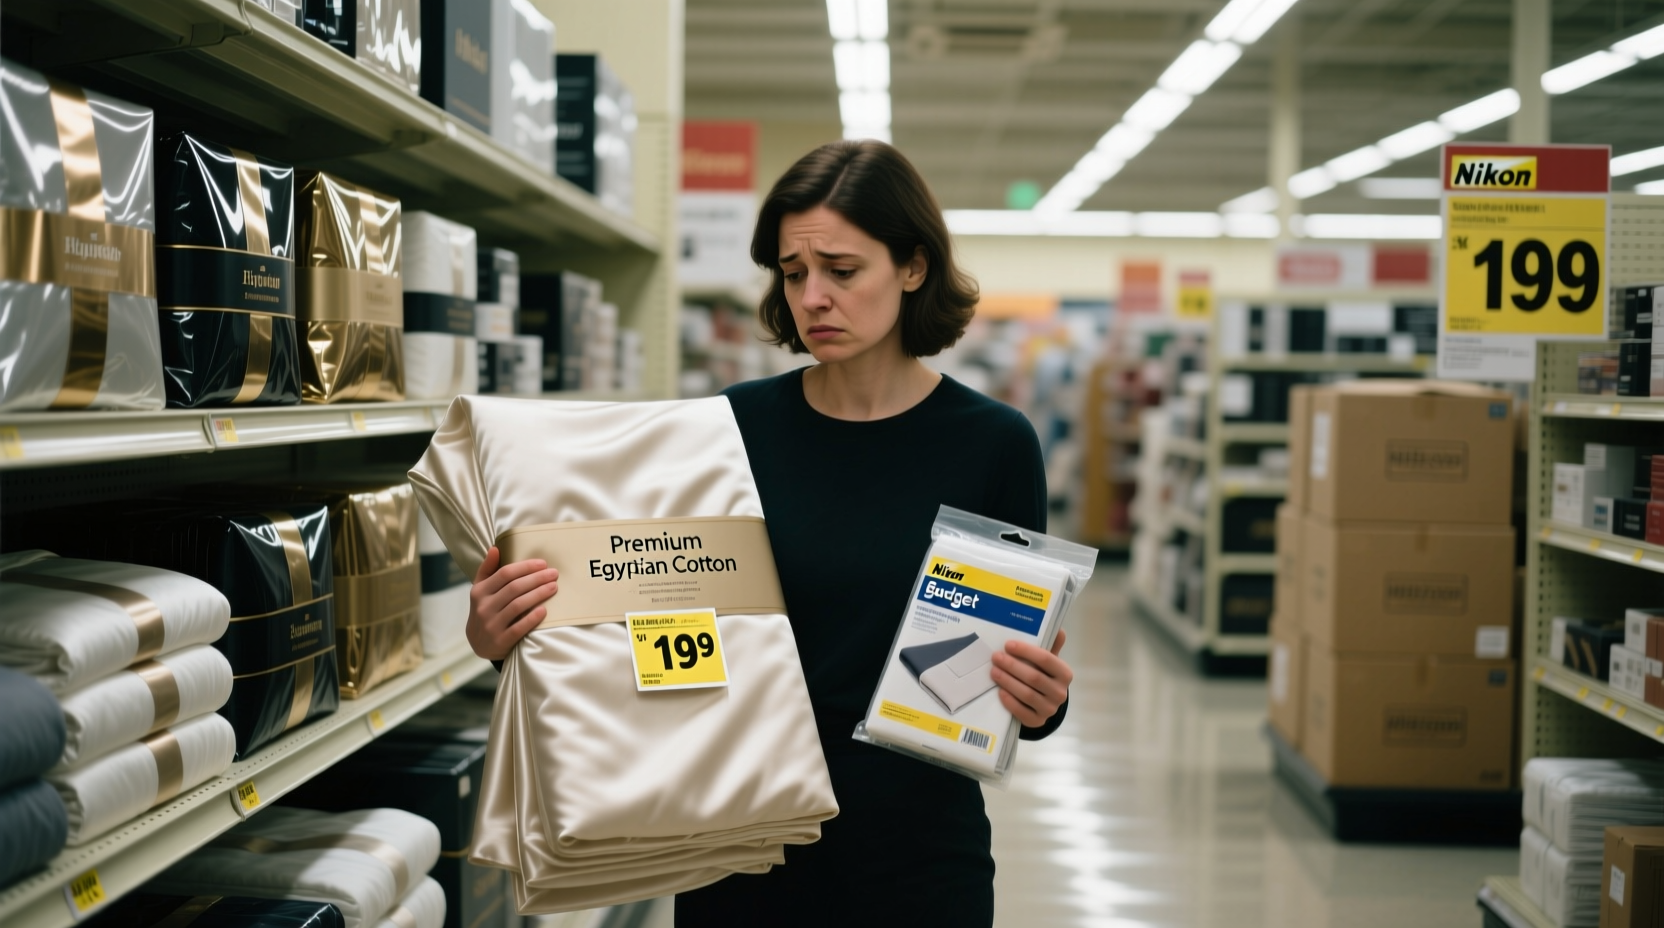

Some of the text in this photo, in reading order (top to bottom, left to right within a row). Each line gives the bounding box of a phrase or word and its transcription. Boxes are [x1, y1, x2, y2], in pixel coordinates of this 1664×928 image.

[1454, 163, 1532, 187] Nikon
[1473, 238, 1600, 314] 199
[610, 531, 704, 554] Premium
[588, 555, 737, 581] Egyptian Cotton
[923, 580, 980, 609] Budget
